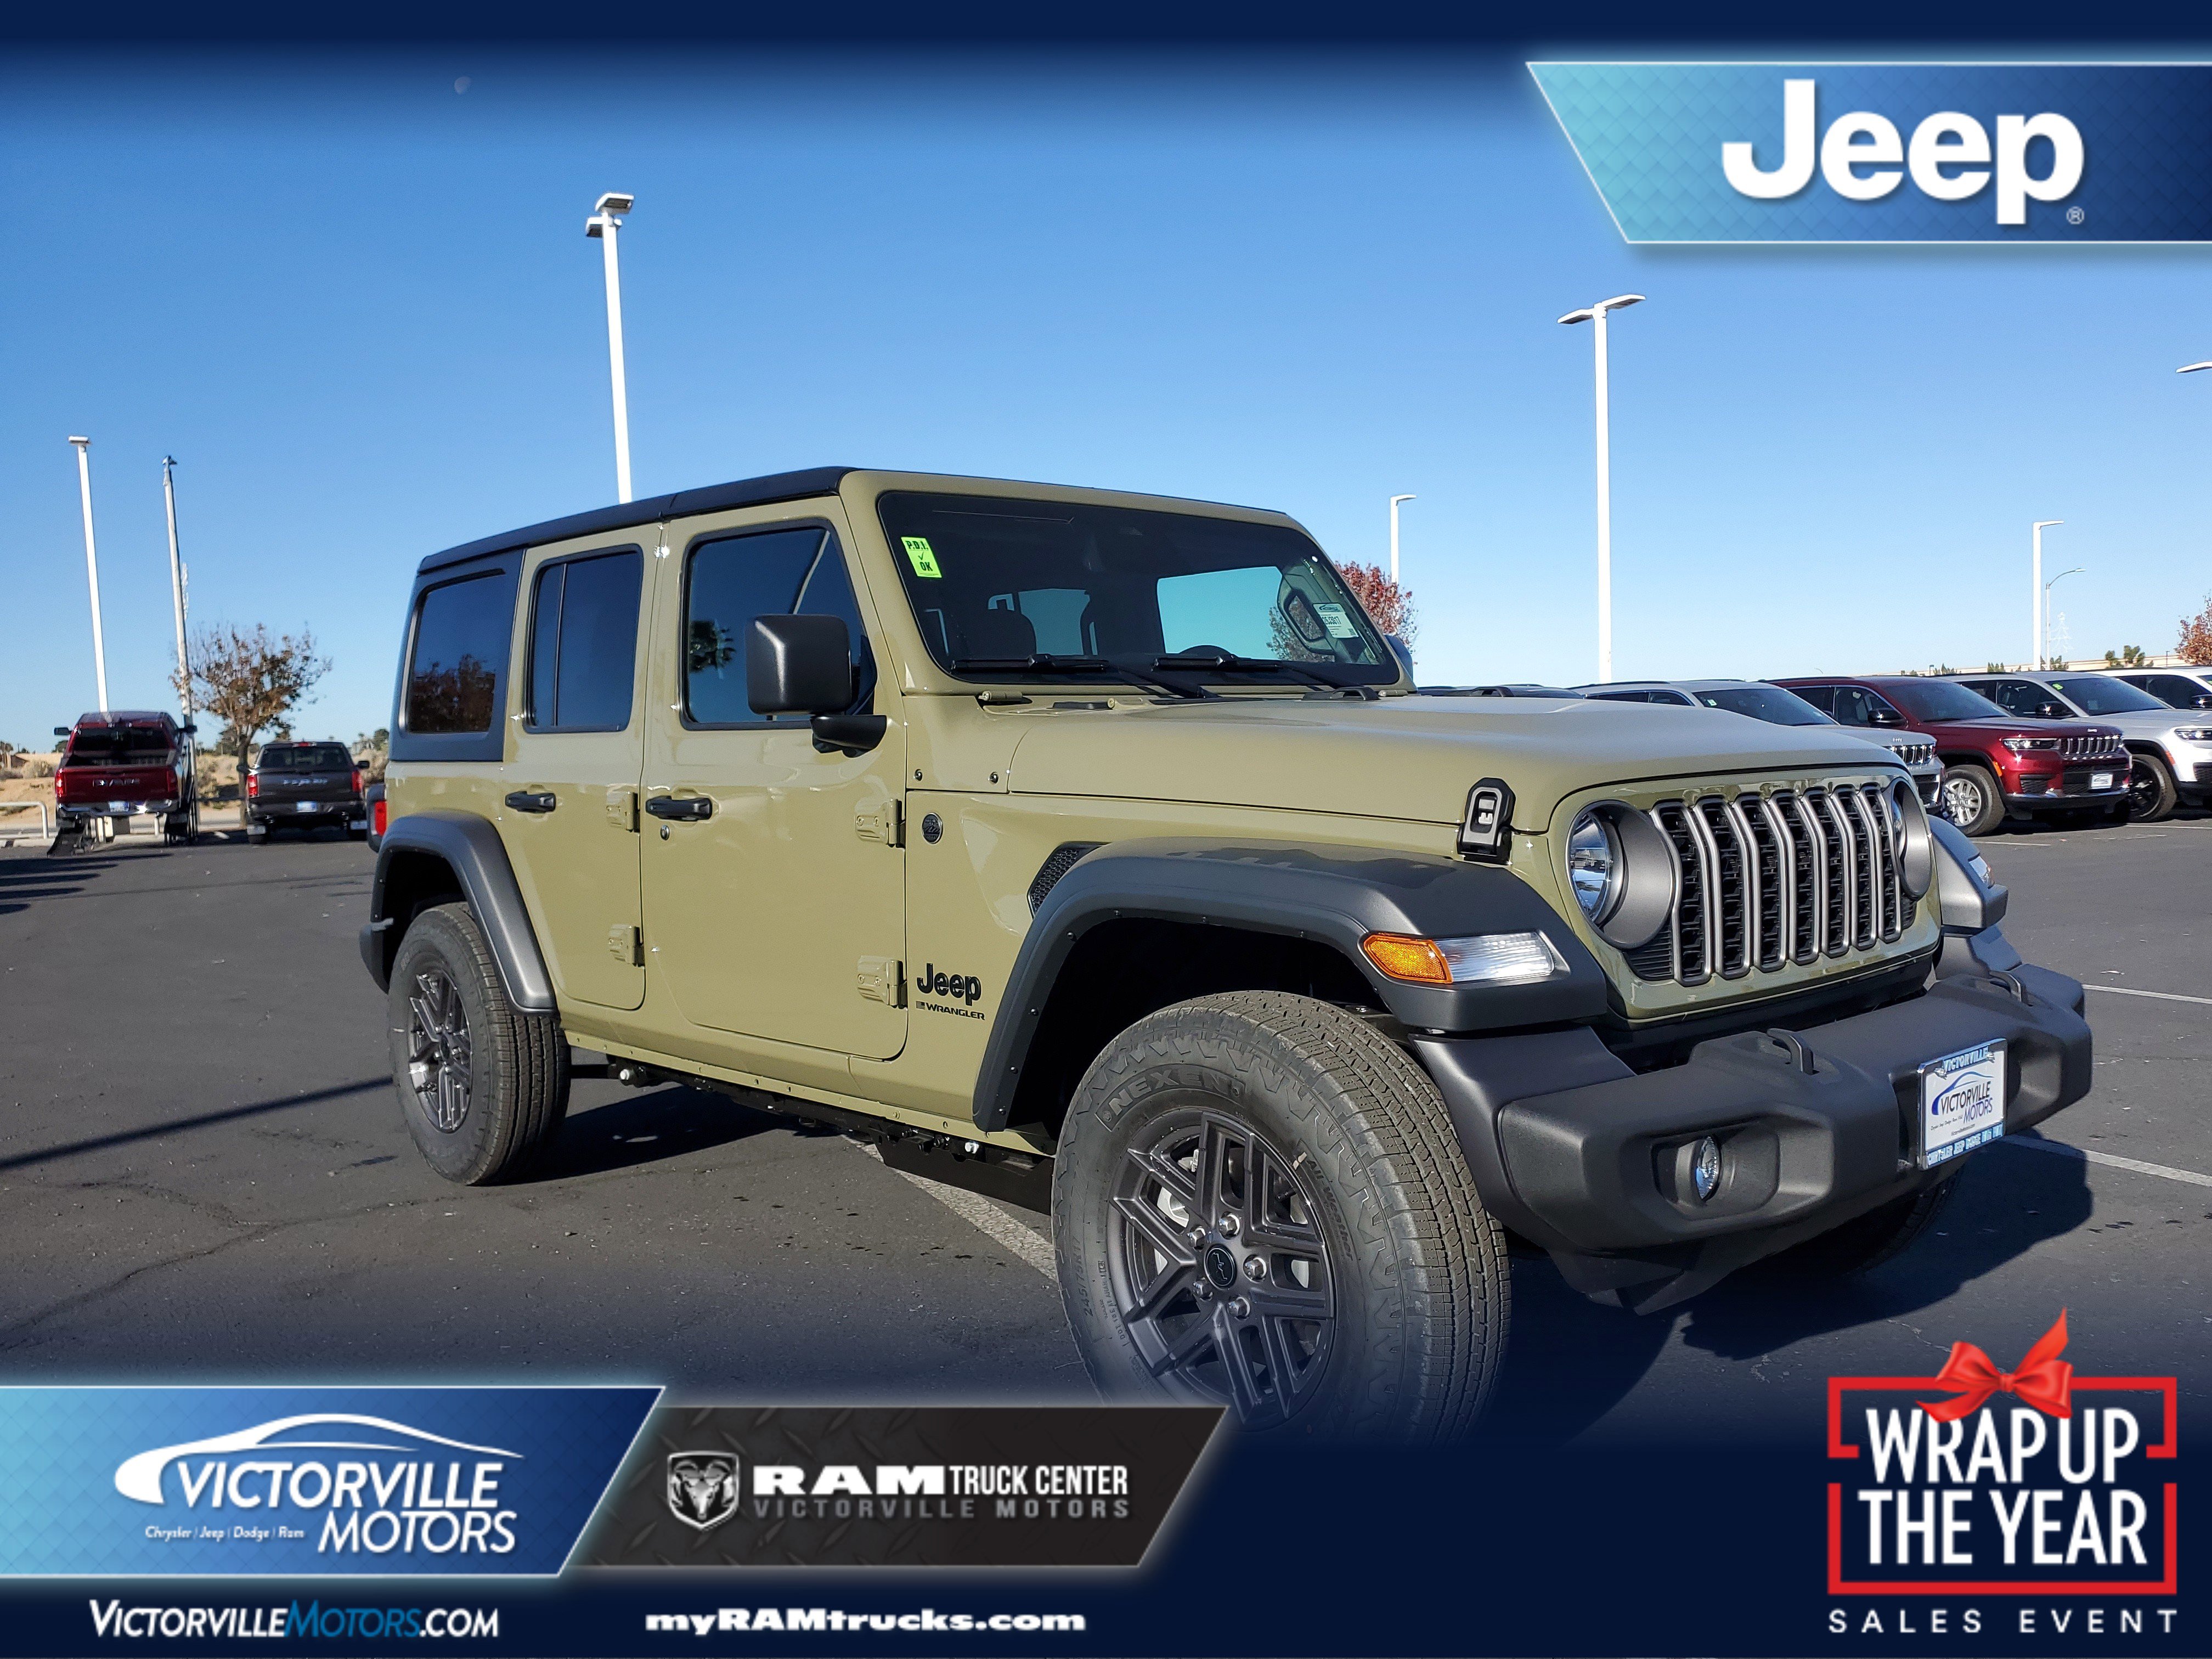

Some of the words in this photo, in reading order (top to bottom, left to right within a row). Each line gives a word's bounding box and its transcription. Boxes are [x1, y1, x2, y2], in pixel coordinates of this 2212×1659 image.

[905, 540, 929, 550] P.D.I.
[919, 561, 933, 571] OK
[917, 962, 981, 1007] Jeep
[926, 1002, 985, 1021] WRANGLER
[1108, 1069, 1232, 1116] NEXEN
[1941, 1081, 1991, 1115] VICTORVILLE
[1963, 1098, 1993, 1124] MOTORS
